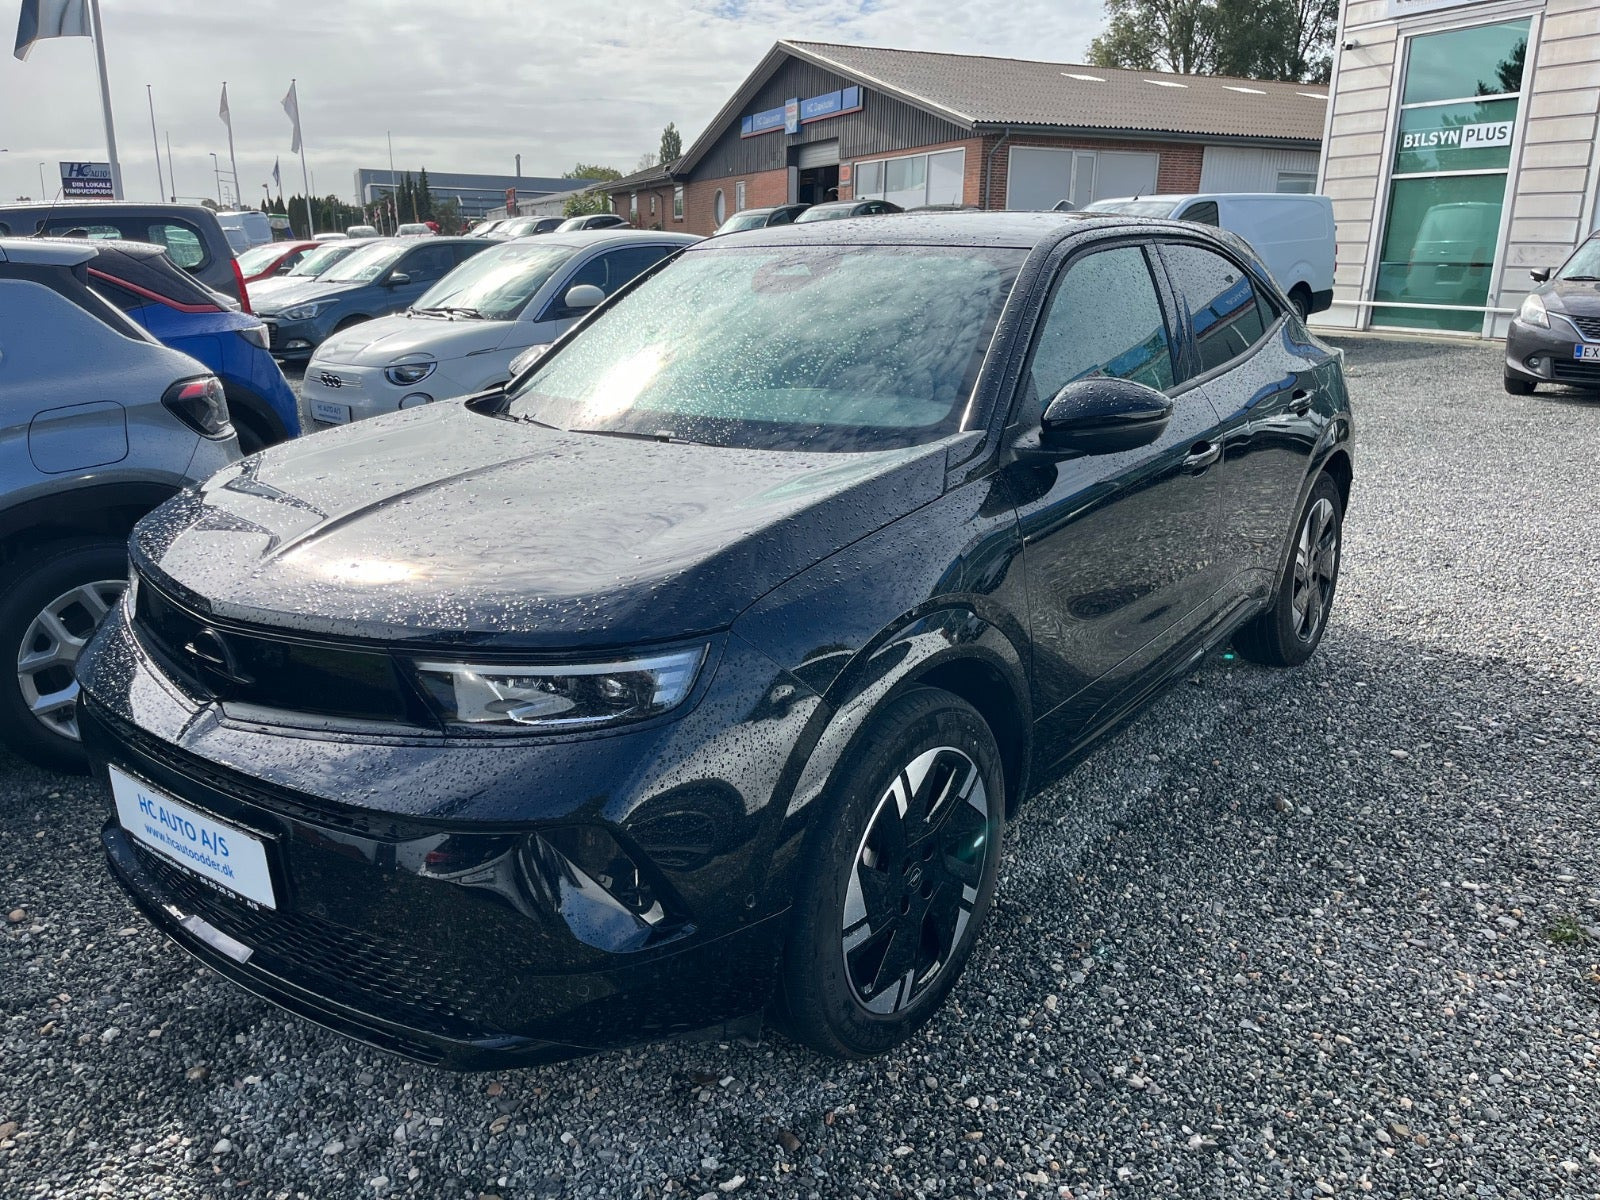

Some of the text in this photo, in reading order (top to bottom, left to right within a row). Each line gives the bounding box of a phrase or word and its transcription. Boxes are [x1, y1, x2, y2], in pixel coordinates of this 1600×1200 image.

[1403, 126, 1508, 148] BILSYN PLUS
[68, 164, 92, 176] HC
[1584, 348, 1599, 357] EX
[137, 793, 229, 857] HC AUTO A/S
[144, 823, 235, 879] www.hcautoodder.dk
